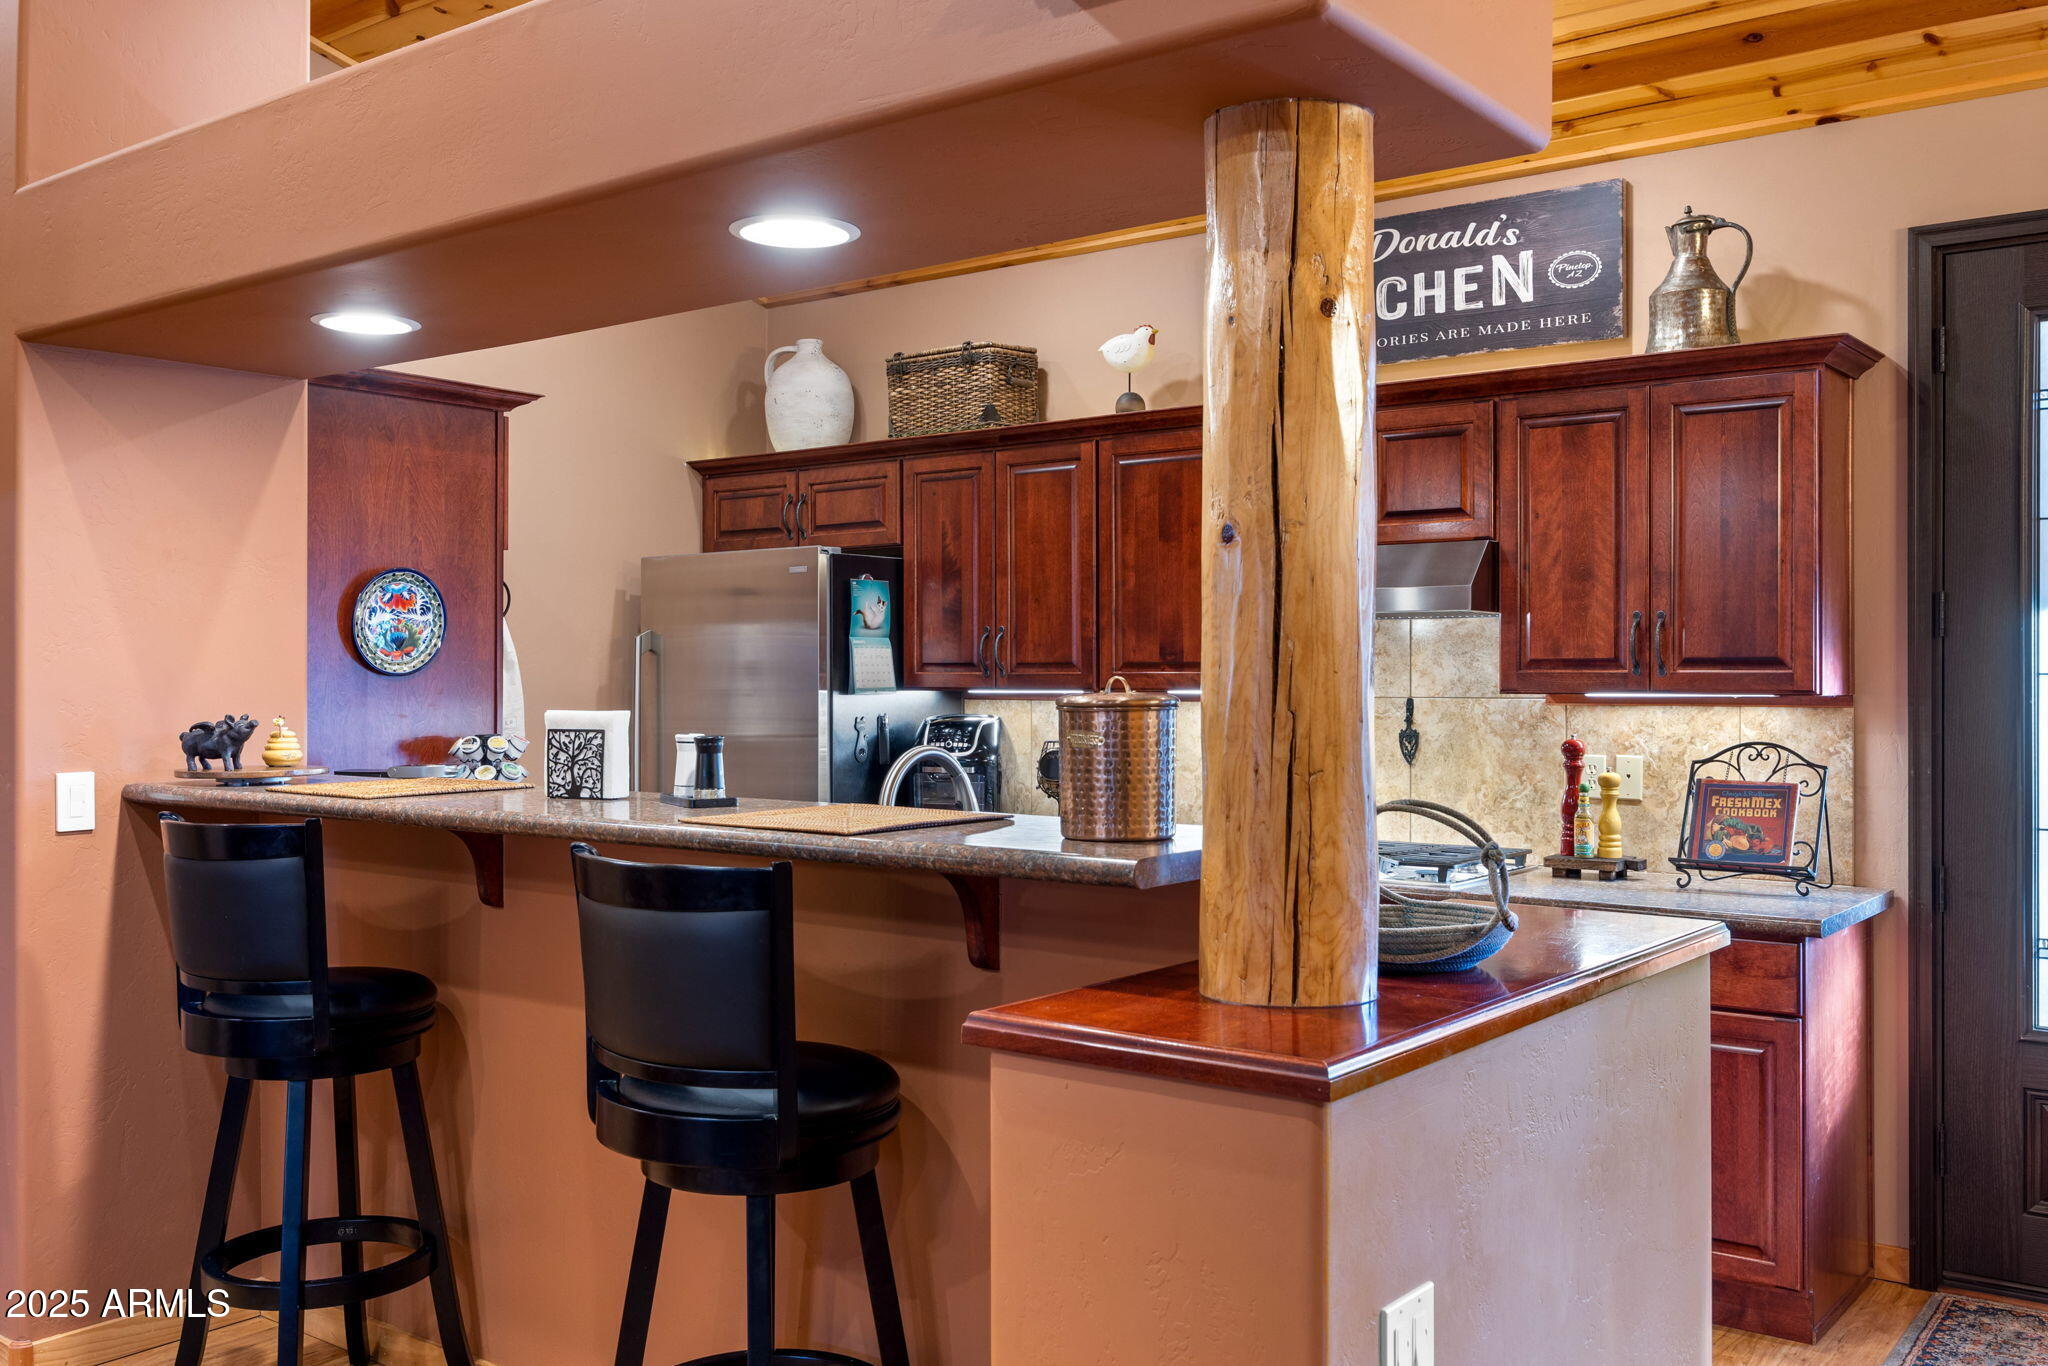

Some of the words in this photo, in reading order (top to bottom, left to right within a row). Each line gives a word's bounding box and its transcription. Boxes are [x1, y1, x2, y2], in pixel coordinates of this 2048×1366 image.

[1373, 214, 1519, 262] Donald's
[1376, 249, 1534, 321] CHEN
[1376, 332, 1429, 348] ORIES
[1435, 327, 1470, 342] ARE
[1478, 319, 1532, 336] MADE
[1539, 312, 1593, 329] HERE
[1711, 795, 1750, 808] FRESH
[1751, 796, 1782, 809] MEX
[1715, 807, 1777, 818] COOKBOOK
